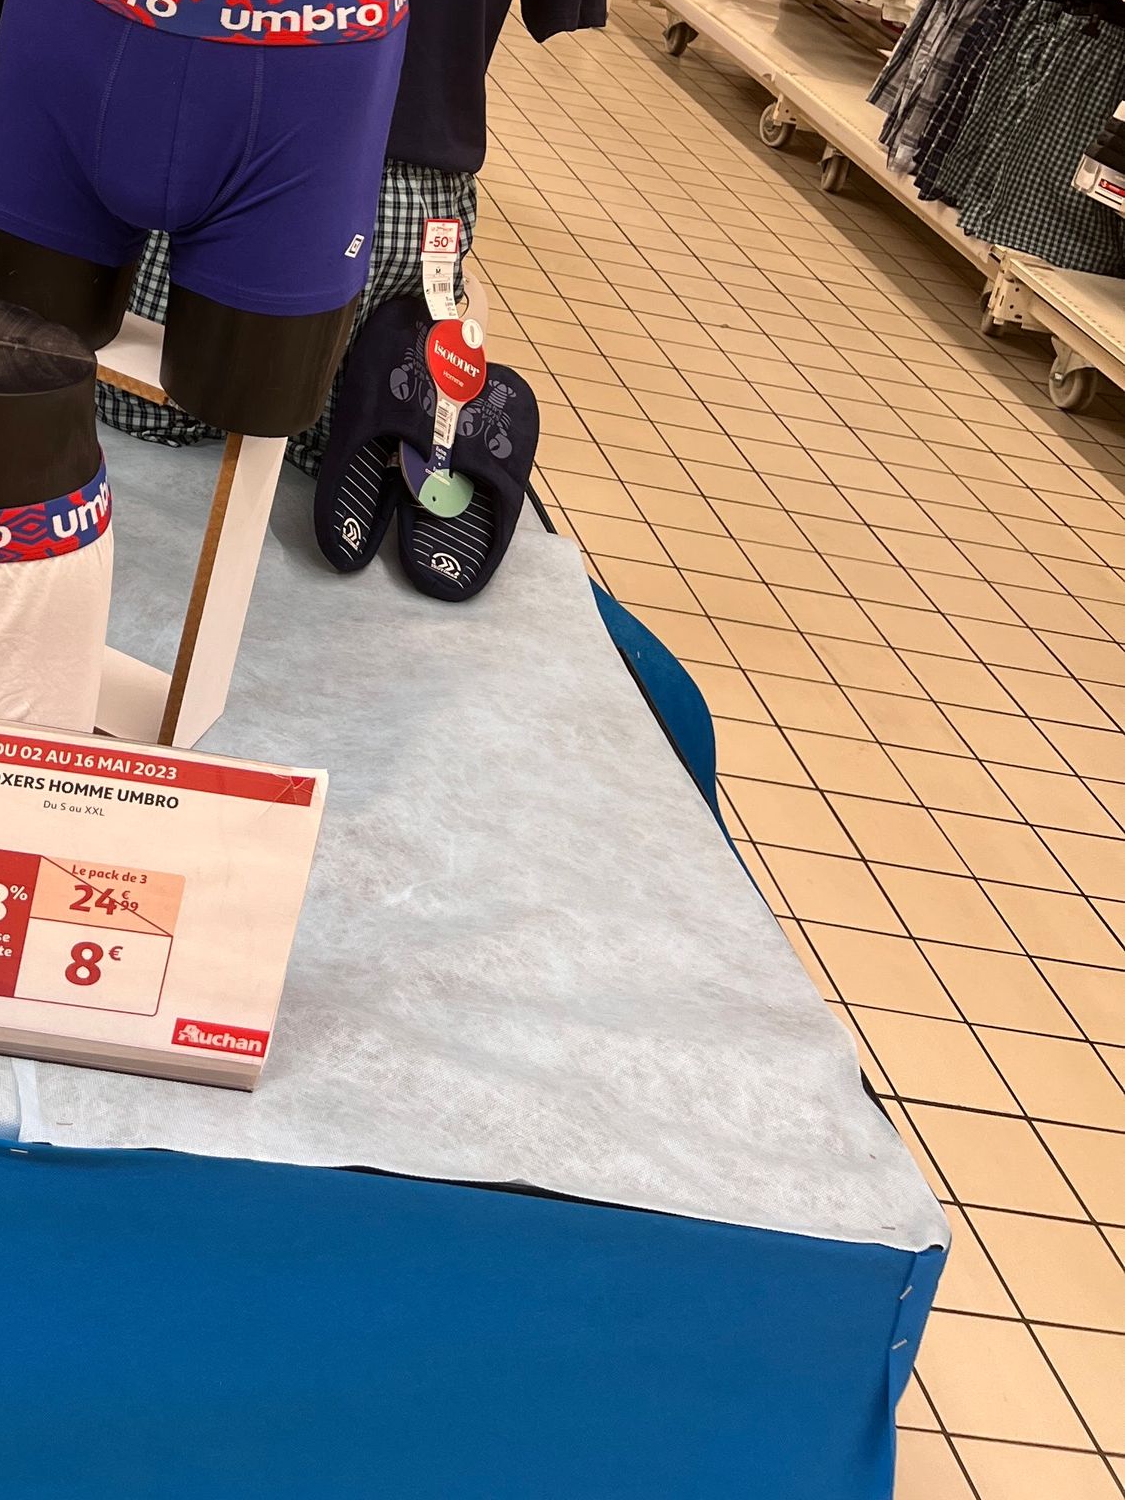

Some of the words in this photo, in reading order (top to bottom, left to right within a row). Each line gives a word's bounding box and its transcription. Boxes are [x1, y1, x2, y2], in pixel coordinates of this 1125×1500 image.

[219, 2, 383, 33] umbro
[434, 339, 481, 378] isotoner
[443, 369, 465, 388] Homme
[20, 745, 43, 761] 02
[45, 749, 72, 765] AU
[74, 753, 95, 768] 16
[97, 756, 131, 774] MAI
[133, 761, 178, 780] 2023
[43, 800, 58, 810] Du
[59, 802, 67, 811] S
[68, 805, 82, 814] au
[84, 805, 106, 817] XXL
[48, 779, 114, 800] HOMME
[116, 788, 180, 809] UMBRO
[71, 864, 86, 877] Le
[88, 869, 121, 882] pack
[122, 871, 138, 884] de
[139, 874, 148, 885] 3
[177, 1023, 263, 1053] Auchan
